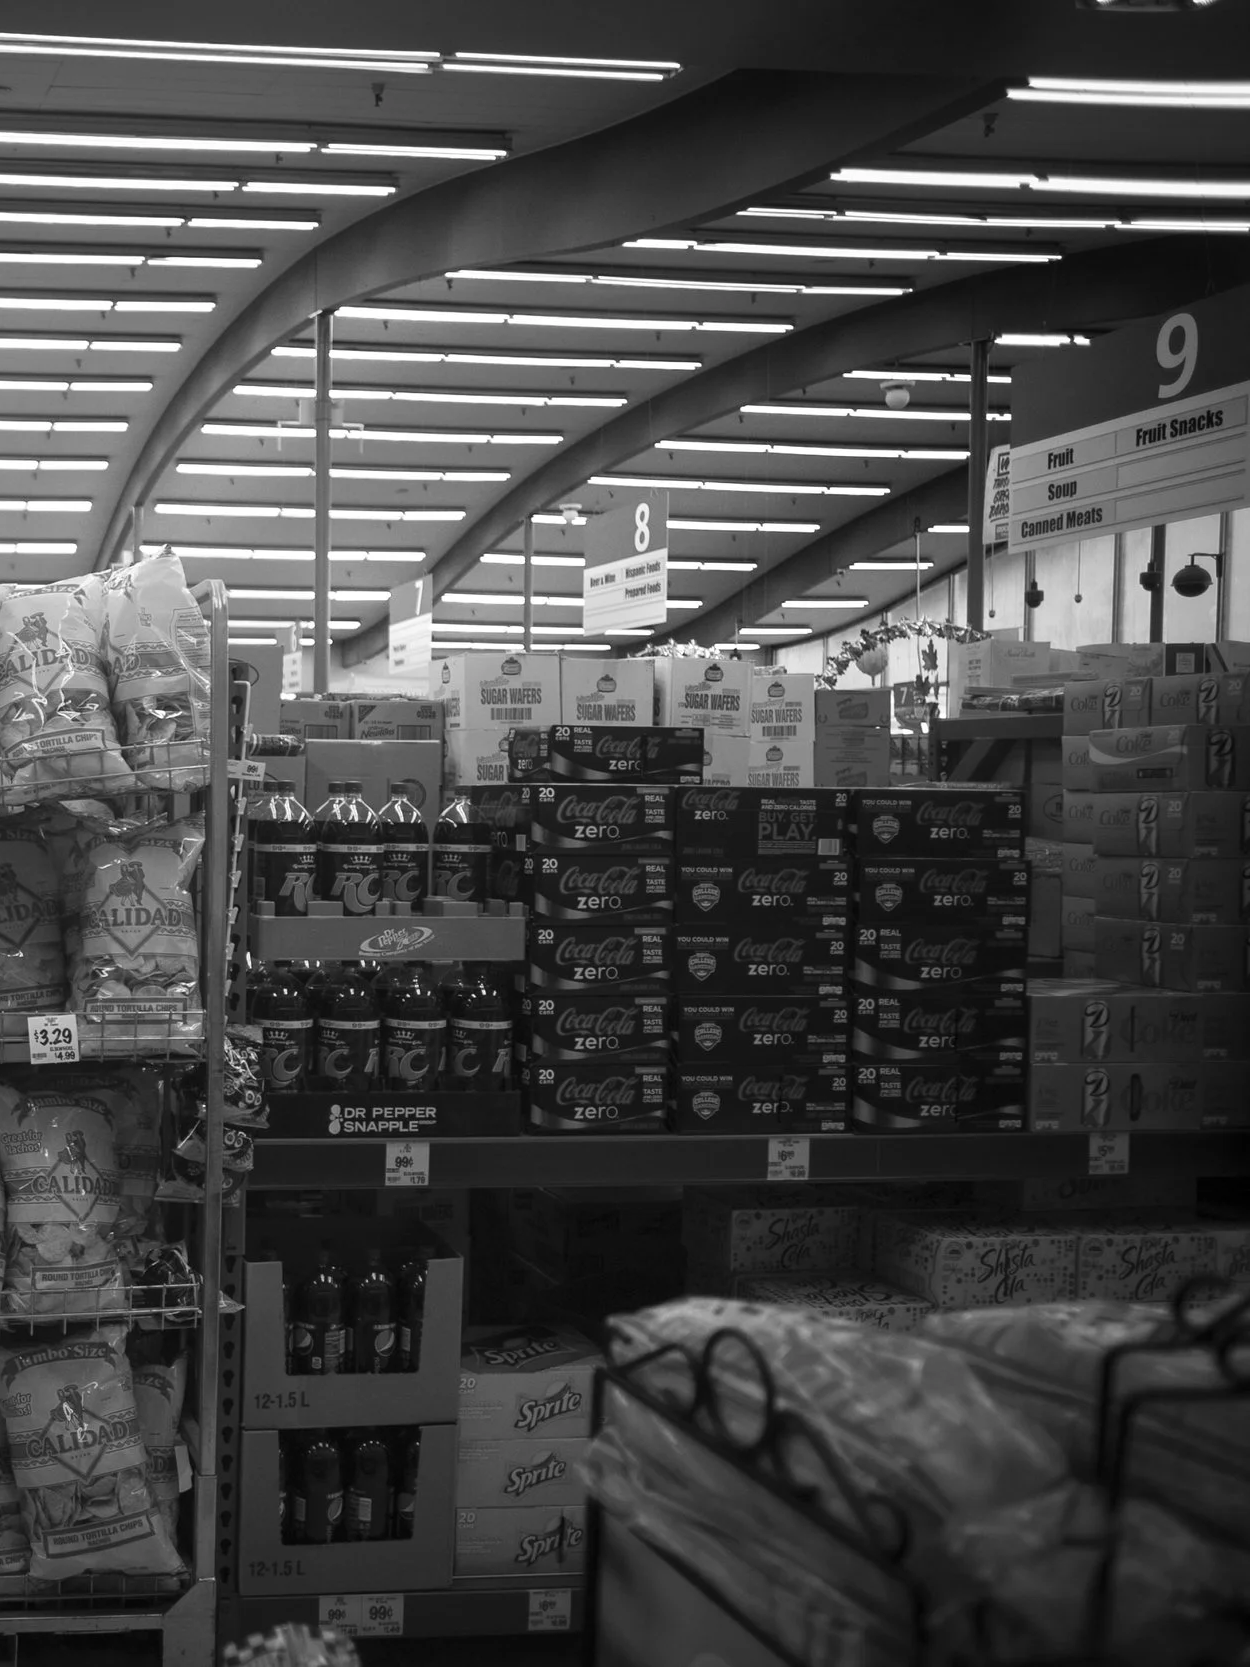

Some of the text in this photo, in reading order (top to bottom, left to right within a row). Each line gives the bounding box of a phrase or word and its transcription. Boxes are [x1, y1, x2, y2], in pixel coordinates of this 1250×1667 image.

[1156, 312, 1199, 399] 9
[1135, 408, 1223, 447] Fruit Snacks
[1047, 448, 1074, 470] Fruit
[1048, 480, 1077, 501] Soup
[634, 502, 650, 552] 8
[1021, 506, 1103, 538] Canned Meats
[481, 687, 542, 705] SUGAR WAFERS
[684, 693, 740, 711] SUGAR WAFERS
[1070, 694, 1098, 713] Coke
[1159, 690, 1191, 710] Coke
[576, 704, 636, 721] SUGAR WAFERS
[751, 707, 803, 723] SUGAR WAFERS
[34, 733, 74, 750] TORTILLA
[1115, 734, 1151, 753] Coke
[477, 764, 504, 781] SUGAR
[748, 771, 799, 787] SUGAR WAFERS
[538, 787, 555, 798] 20
[680, 788, 742, 811] Coca-Cola
[556, 795, 639, 825] Coca-Cola
[645, 808, 665, 816] TASTE
[758, 811, 818, 823] BUY. GET.
[916, 801, 986, 826] Coca-Cola
[1008, 805, 1022, 814] 20
[1100, 808, 1130, 826] Coke
[758, 822, 817, 841] PLAY.
[542, 858, 558, 869] 20
[645, 865, 666, 873] REAL
[559, 865, 641, 895] Coca-Cola
[329, 872, 381, 914] RC
[88, 908, 184, 928] CALIDAD
[538, 1000, 555, 1011] 20
[642, 1005, 663, 1013] REAL
[555, 1006, 639, 1036] Coca-Cola
[642, 1018, 663, 1026] TASTE
[739, 1007, 809, 1033] Coca-Cola
[34, 1027, 73, 1047] $3.29
[538, 1069, 555, 1080] 20
[642, 1074, 663, 1082] REAL
[857, 1068, 877, 1079] 20
[880, 1067, 901, 1075] REAL
[343, 1106, 437, 1120] DR PEPPER
[343, 1120, 419, 1133] SNAPPLE
[1, 1129, 43, 1145] Great for
[395, 1156, 414, 1168] 99¢
[32, 1174, 114, 1197] CALIDAD
[765, 1214, 821, 1249] Shasta
[1119, 1241, 1177, 1281] Shasta
[41, 1272, 69, 1283] ROUND
[14, 1344, 107, 1370] Jumbo Size
[483, 1337, 556, 1367] Sprite
[458, 1376, 476, 1390] 20
[253, 1392, 311, 1410] 12-1.5 L
[514, 1390, 582, 1432] Sprite
[26, 1420, 129, 1459] CALIDAD
[505, 1456, 567, 1497] Sprite
[458, 1512, 476, 1524] 20
[53, 1518, 143, 1546] ROUND TORTILLA CHIPS
[249, 1560, 306, 1577] 12-1.5 L
[369, 1606, 393, 1620] 99¢
